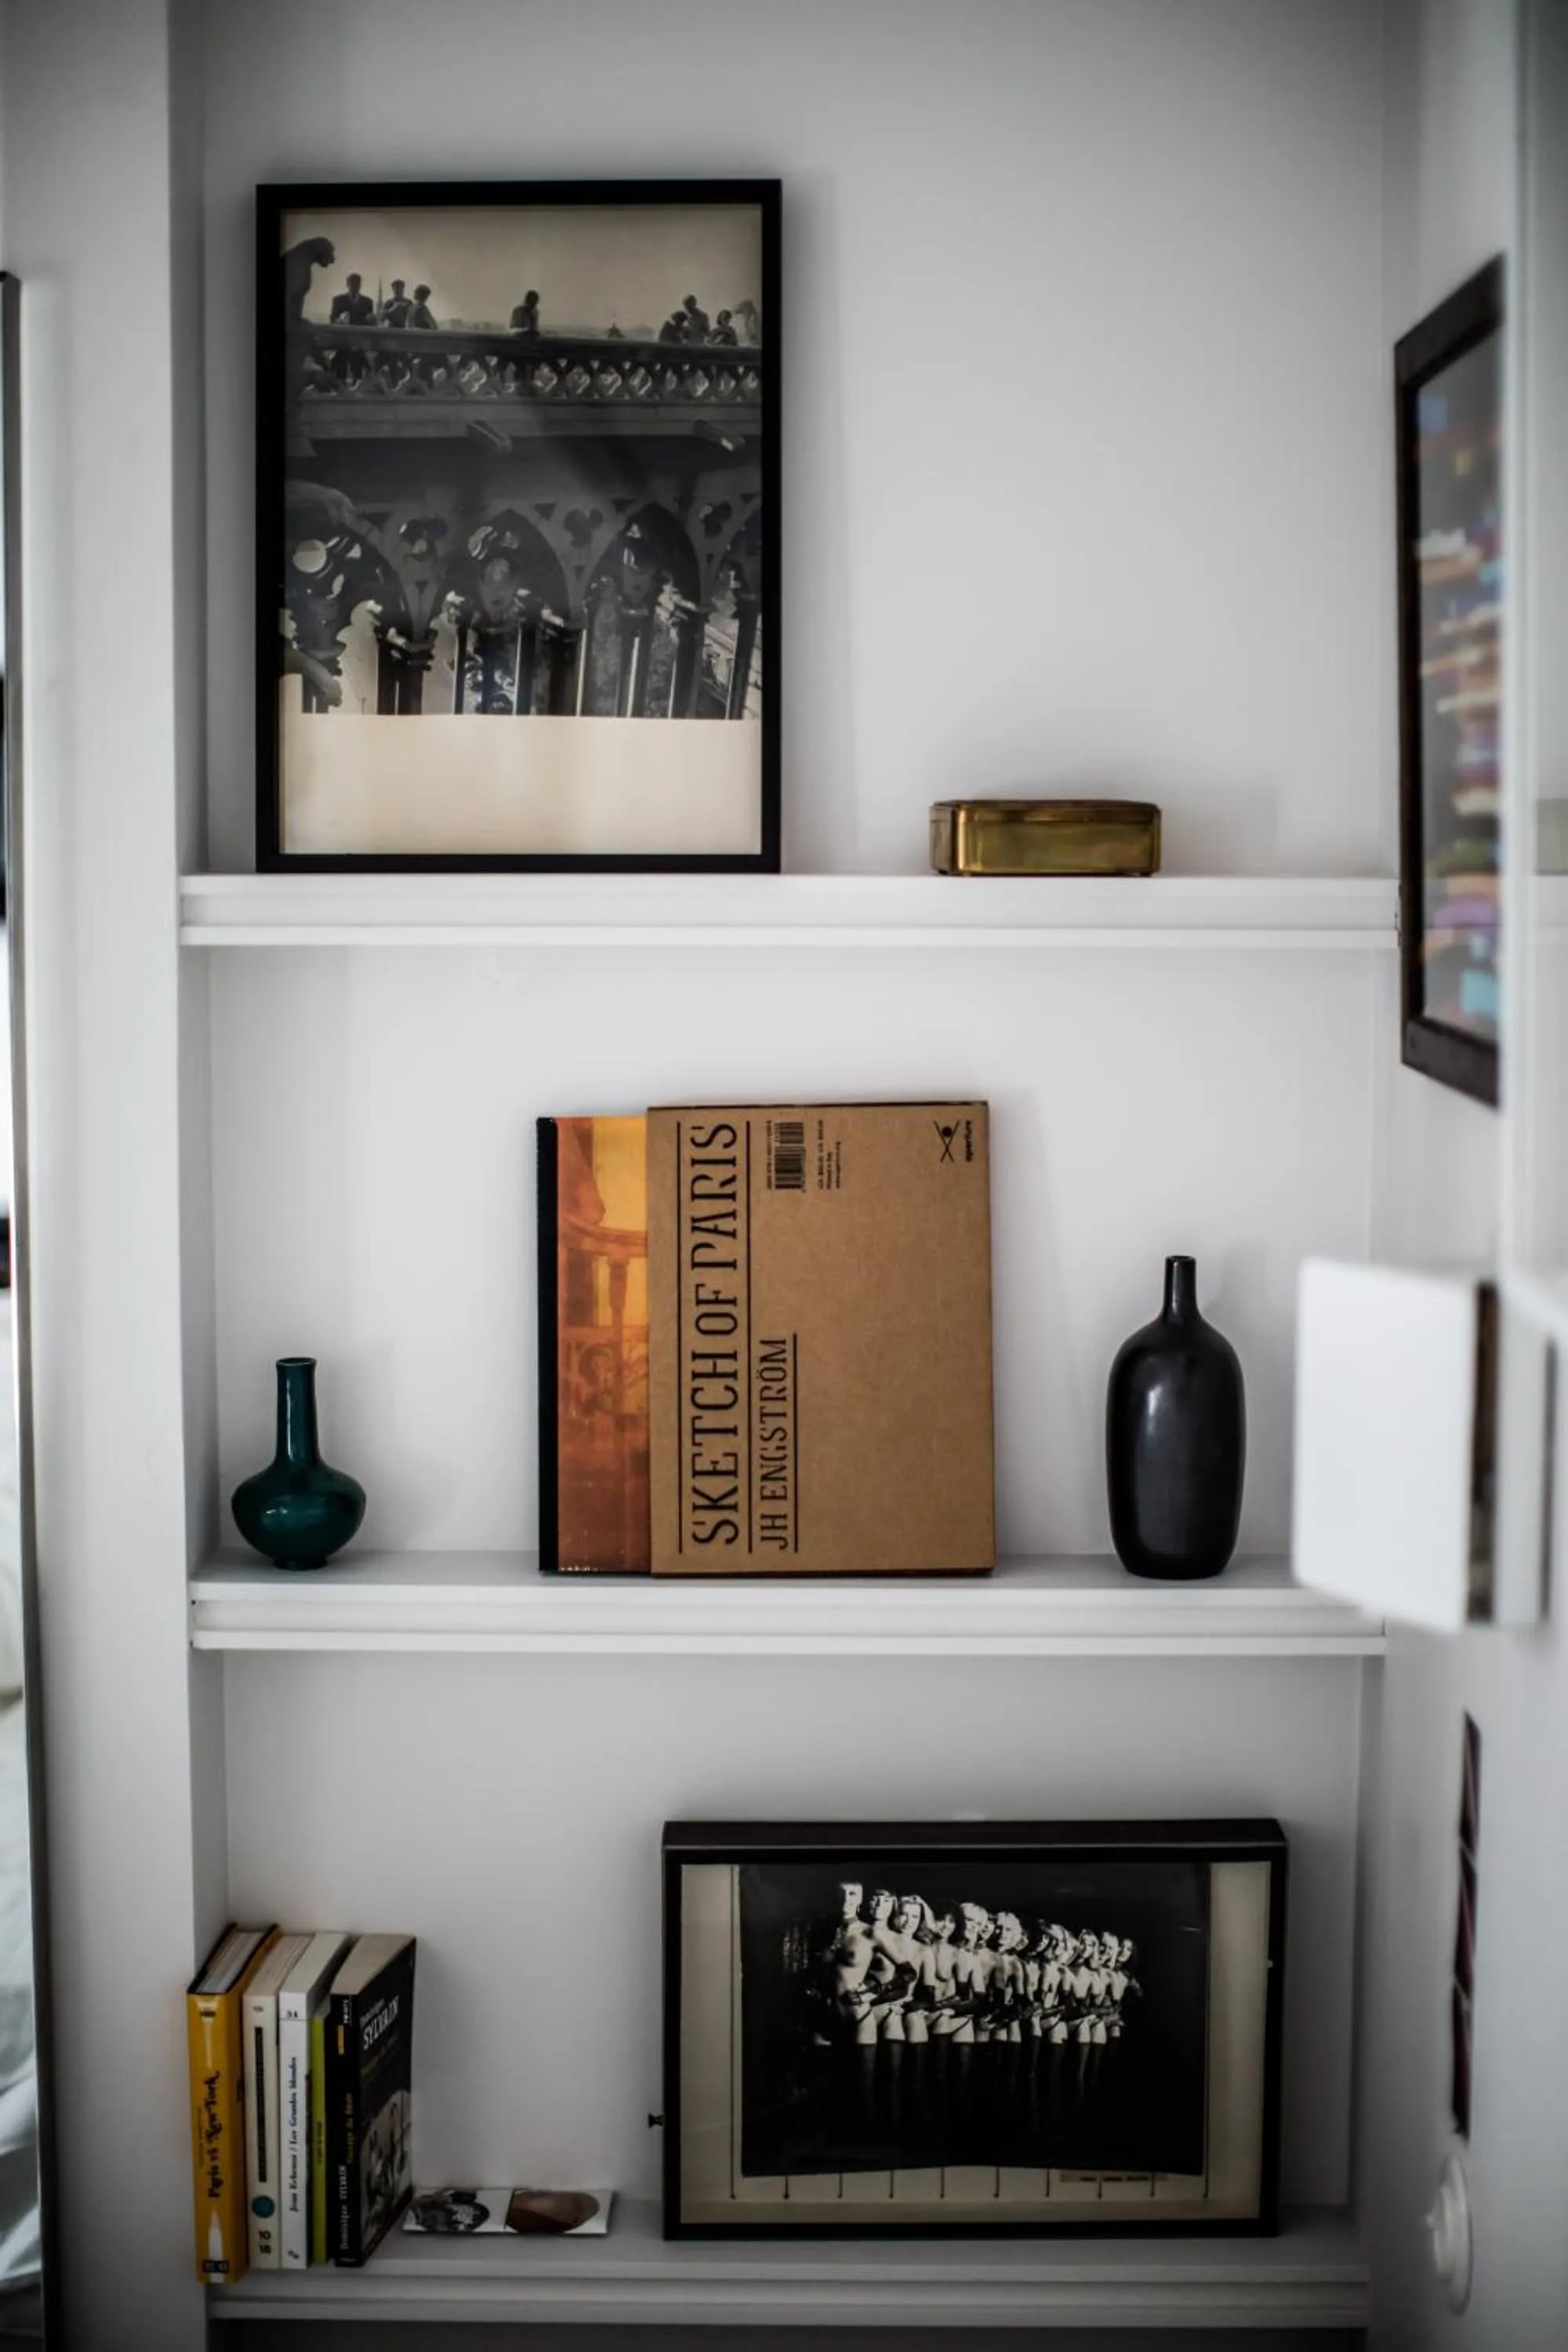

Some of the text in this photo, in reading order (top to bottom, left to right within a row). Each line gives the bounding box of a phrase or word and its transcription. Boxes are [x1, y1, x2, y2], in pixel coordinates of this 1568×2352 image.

[964, 1119, 975, 1163] aperture
[690, 1123, 739, 1545] SKETCH OF PARIS
[757, 1338, 789, 1551] JH ENGSTRÖM
[258, 2230, 271, 2241] 10
